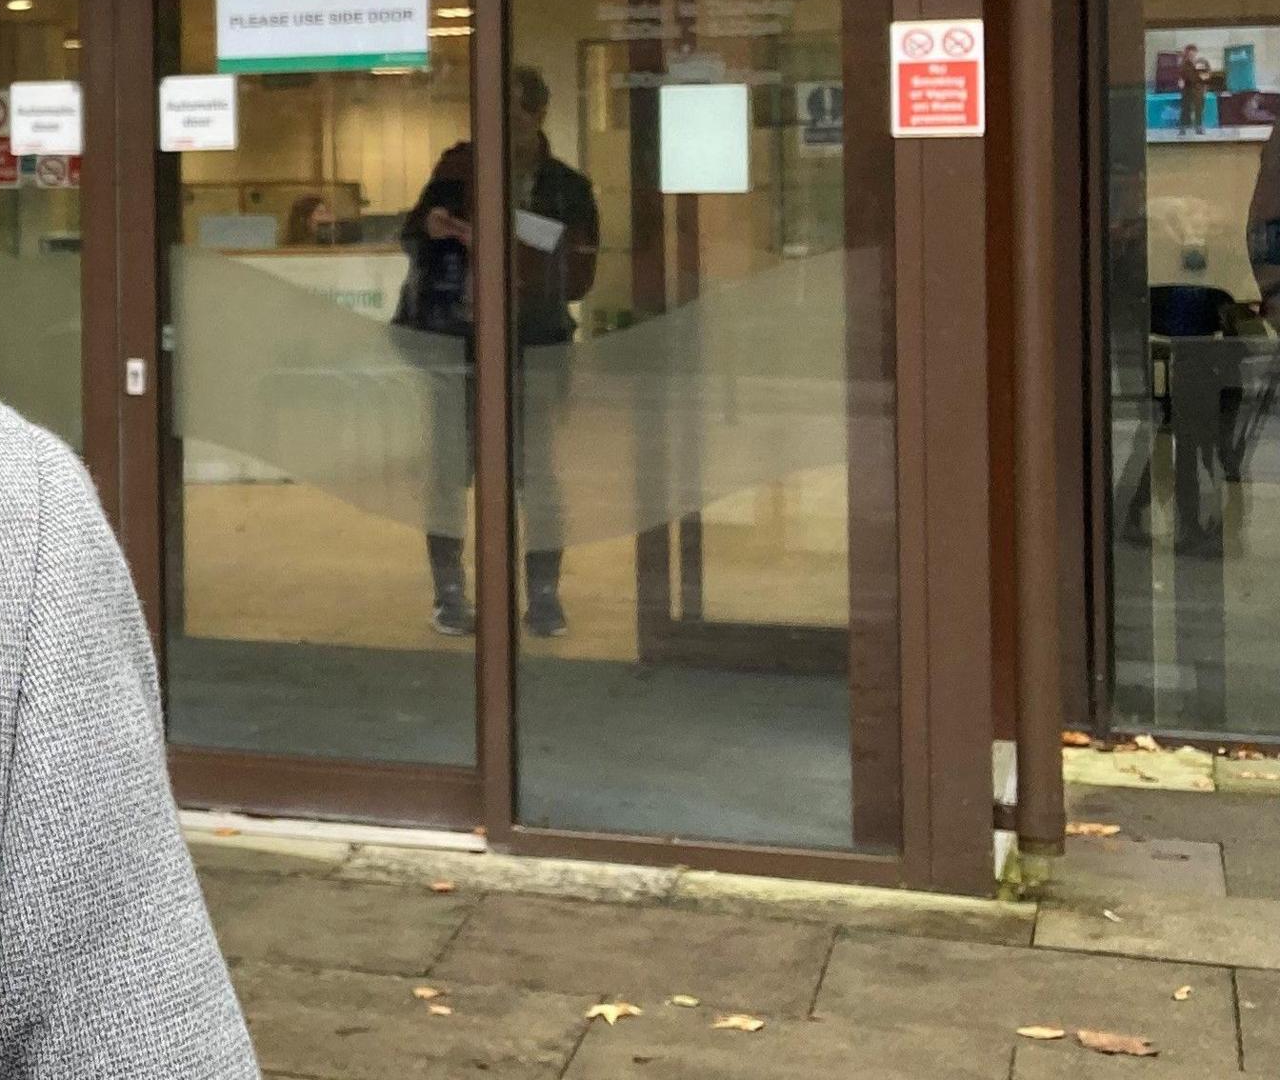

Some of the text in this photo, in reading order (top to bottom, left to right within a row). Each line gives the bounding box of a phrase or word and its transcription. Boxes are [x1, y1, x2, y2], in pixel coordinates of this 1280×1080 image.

[230, 9, 413, 29] PLEASE USE SIDE DOOR
